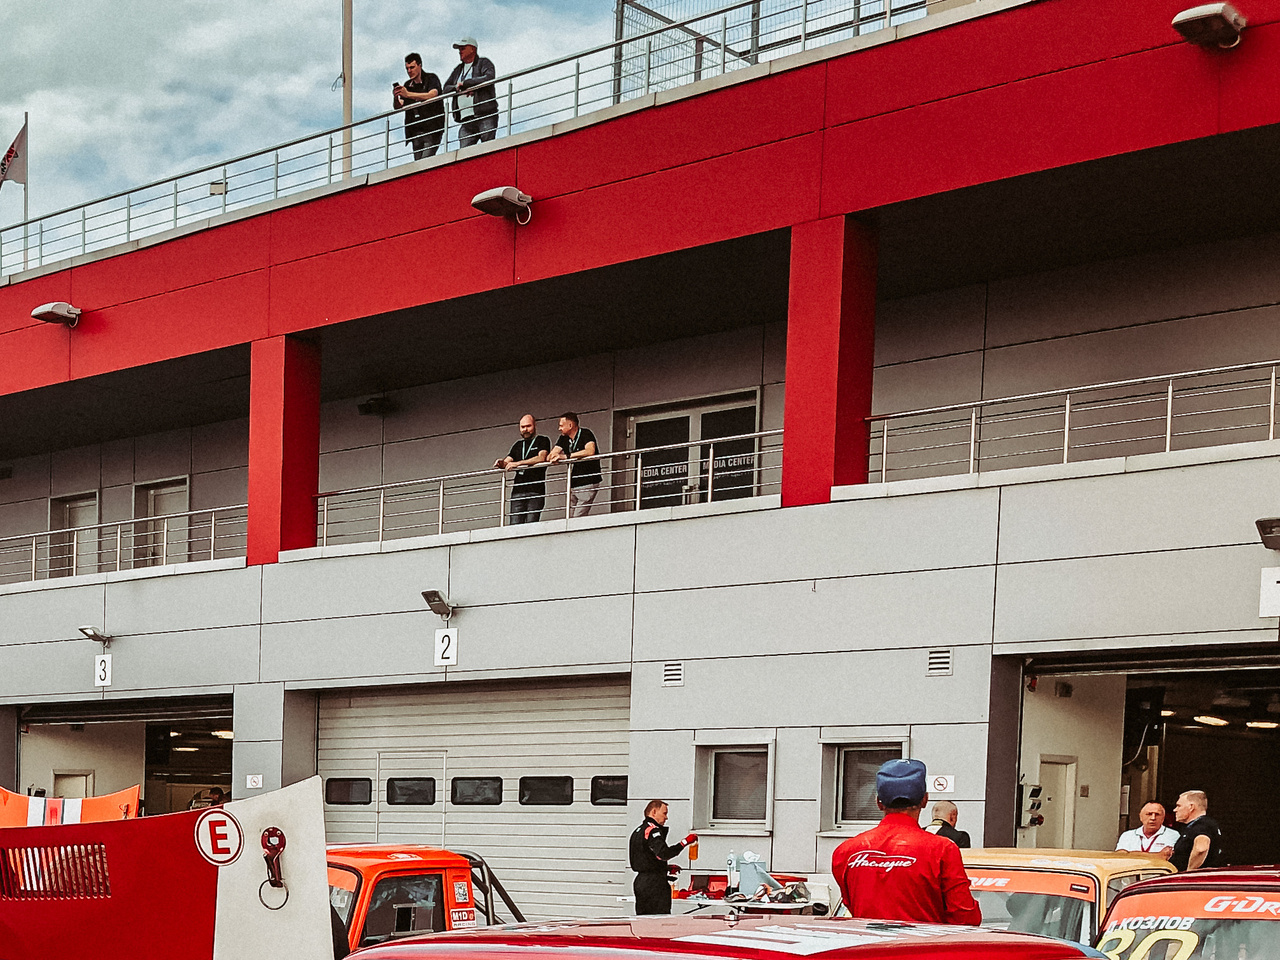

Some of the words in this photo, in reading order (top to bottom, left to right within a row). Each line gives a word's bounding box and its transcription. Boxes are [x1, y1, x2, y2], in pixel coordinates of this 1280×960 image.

[661, 464, 687, 475] CENTER
[703, 459, 727, 470] MDIA
[728, 455, 754, 467] CENTER
[441, 636, 451, 660] 2
[99, 660, 107, 681] 3
[209, 820, 231, 855] E
[847, 849, 917, 872] Наследие
[969, 877, 1010, 887] RIVE
